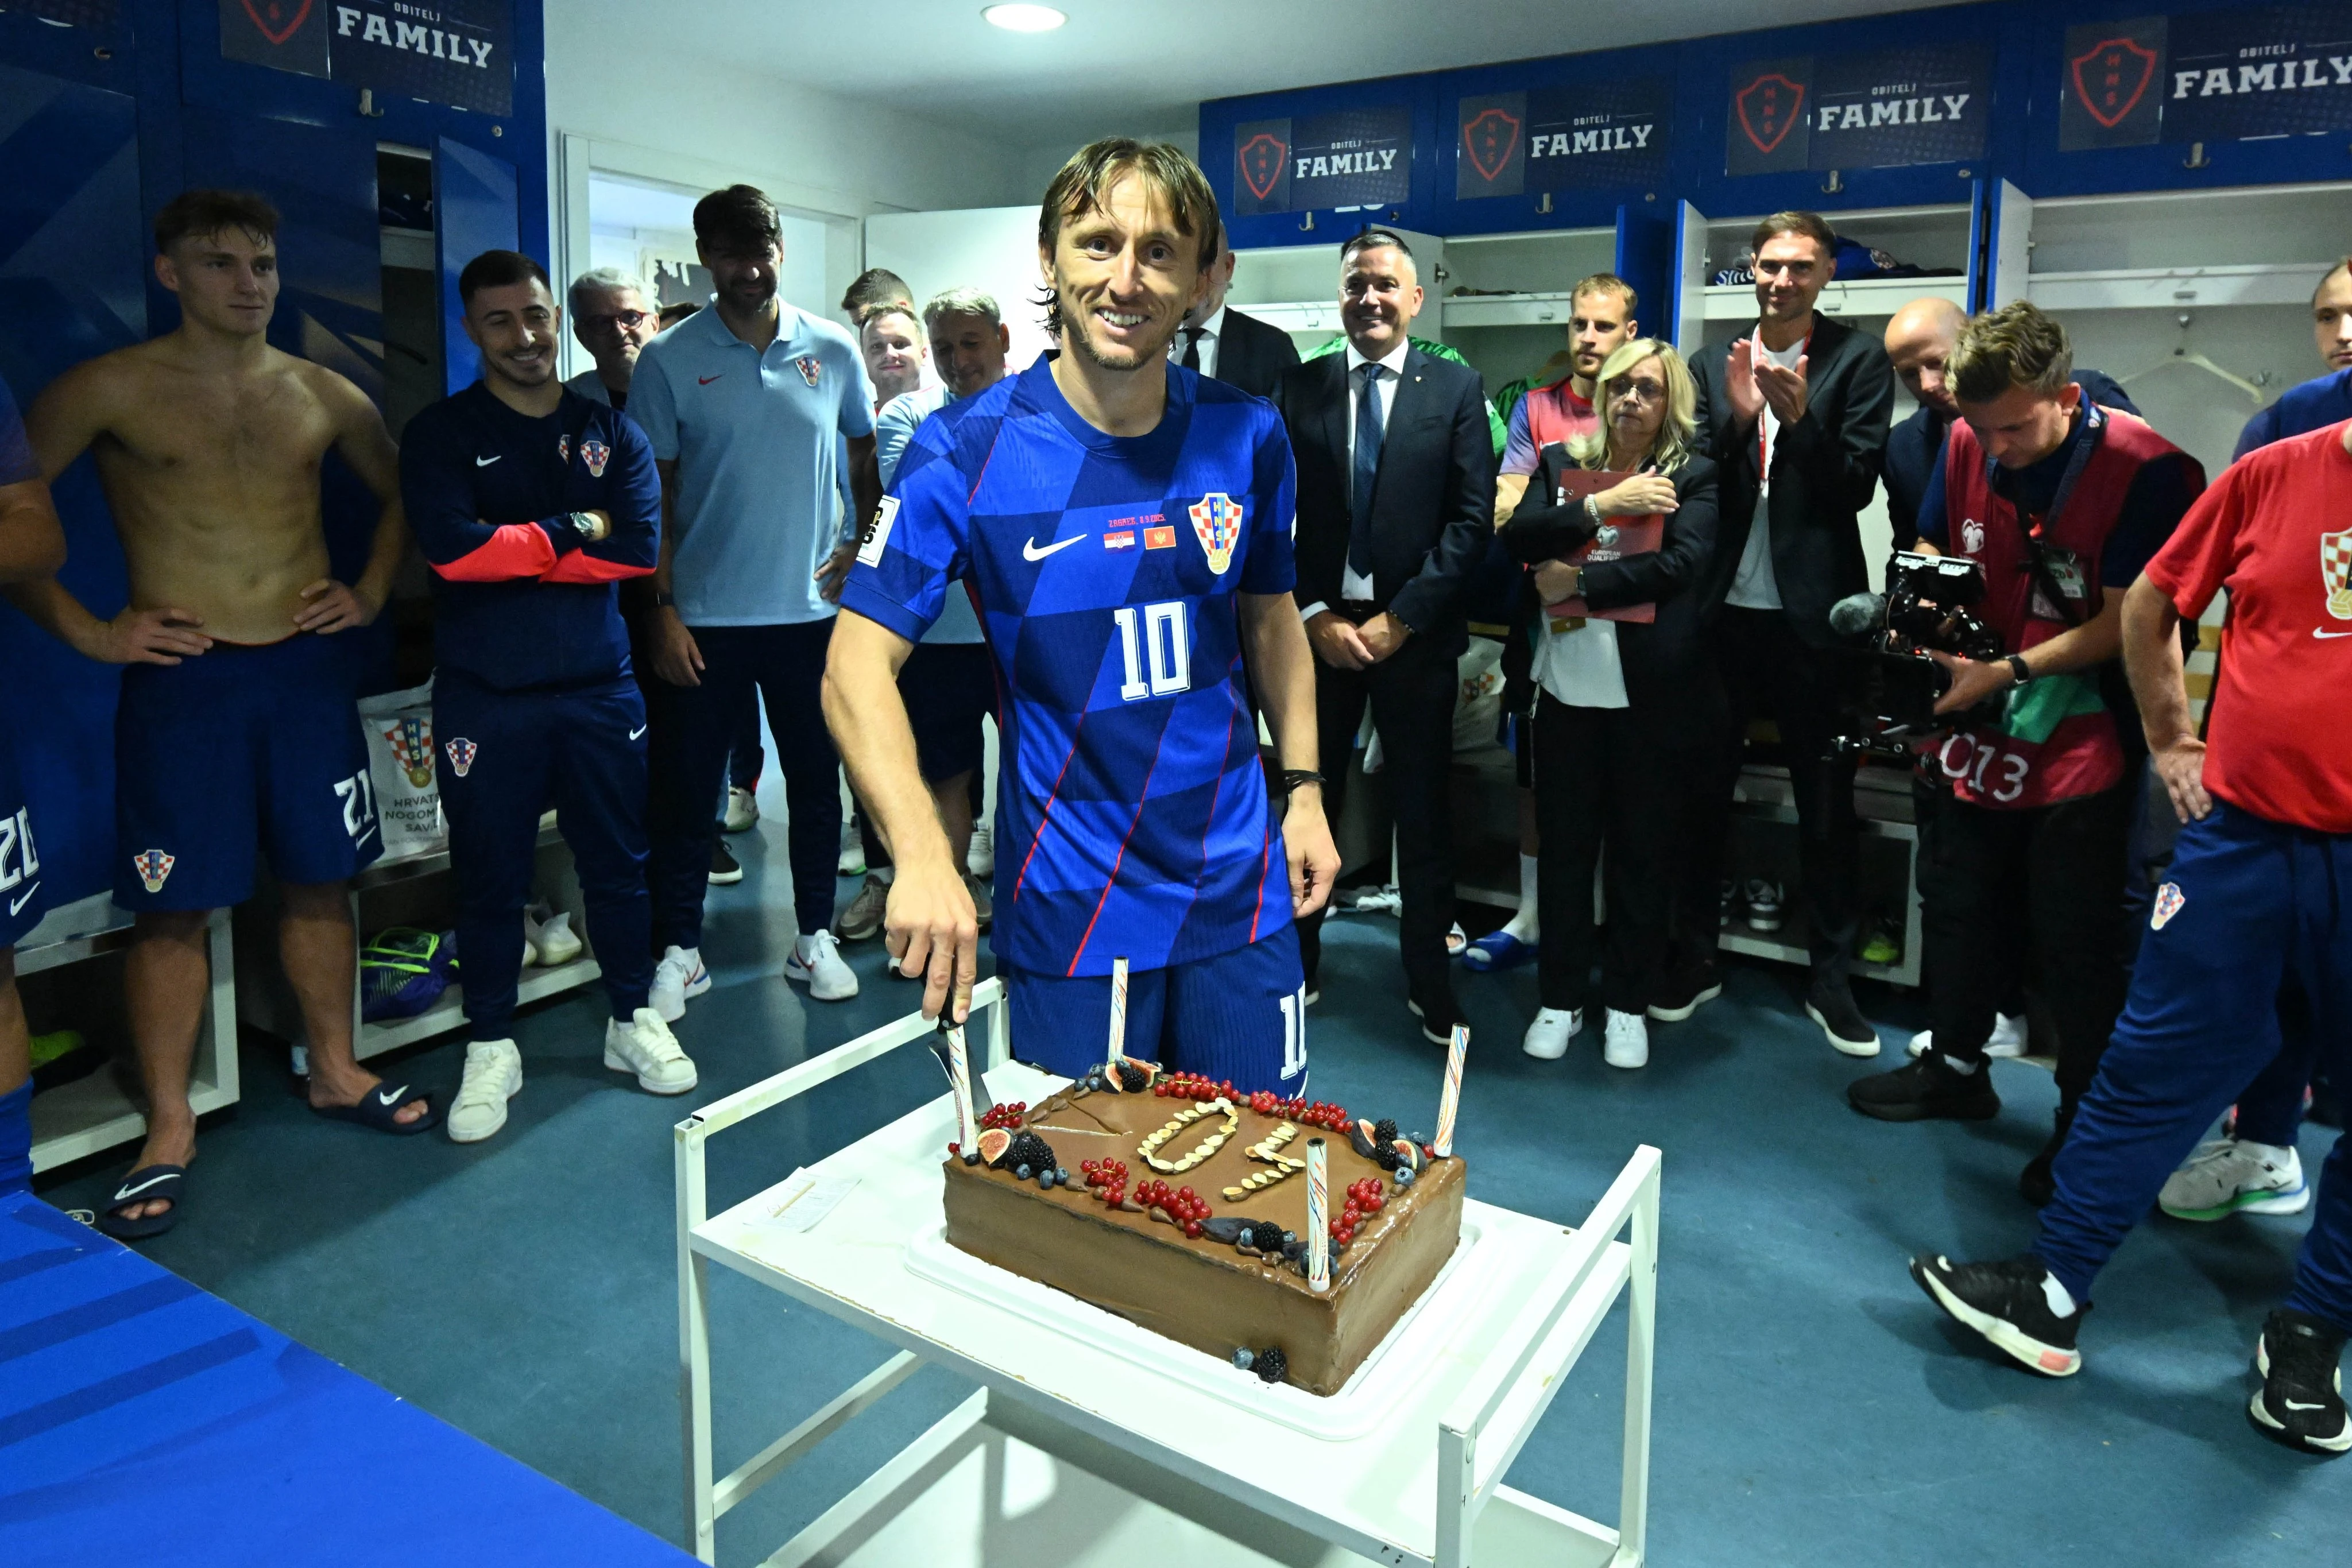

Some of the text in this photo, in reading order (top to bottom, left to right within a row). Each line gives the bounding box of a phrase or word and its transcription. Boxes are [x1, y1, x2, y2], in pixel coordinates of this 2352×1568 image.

[394, 2, 440, 22] OBITELJ
[337, 6, 493, 68] FAMILY
[2239, 43, 2296, 58] OBITELJ
[2173, 56, 2352, 99] FAMILY
[1573, 114, 1610, 126] OBITELJ
[1819, 94, 1970, 131] FAMILY
[1331, 140, 1361, 150] OBITELJ
[1531, 125, 1653, 157] FAMILY
[1296, 149, 1397, 179] FAMILY
[1213, 501, 1223, 541] HNS
[1114, 601, 1190, 702] 10
[334, 768, 374, 837] 21
